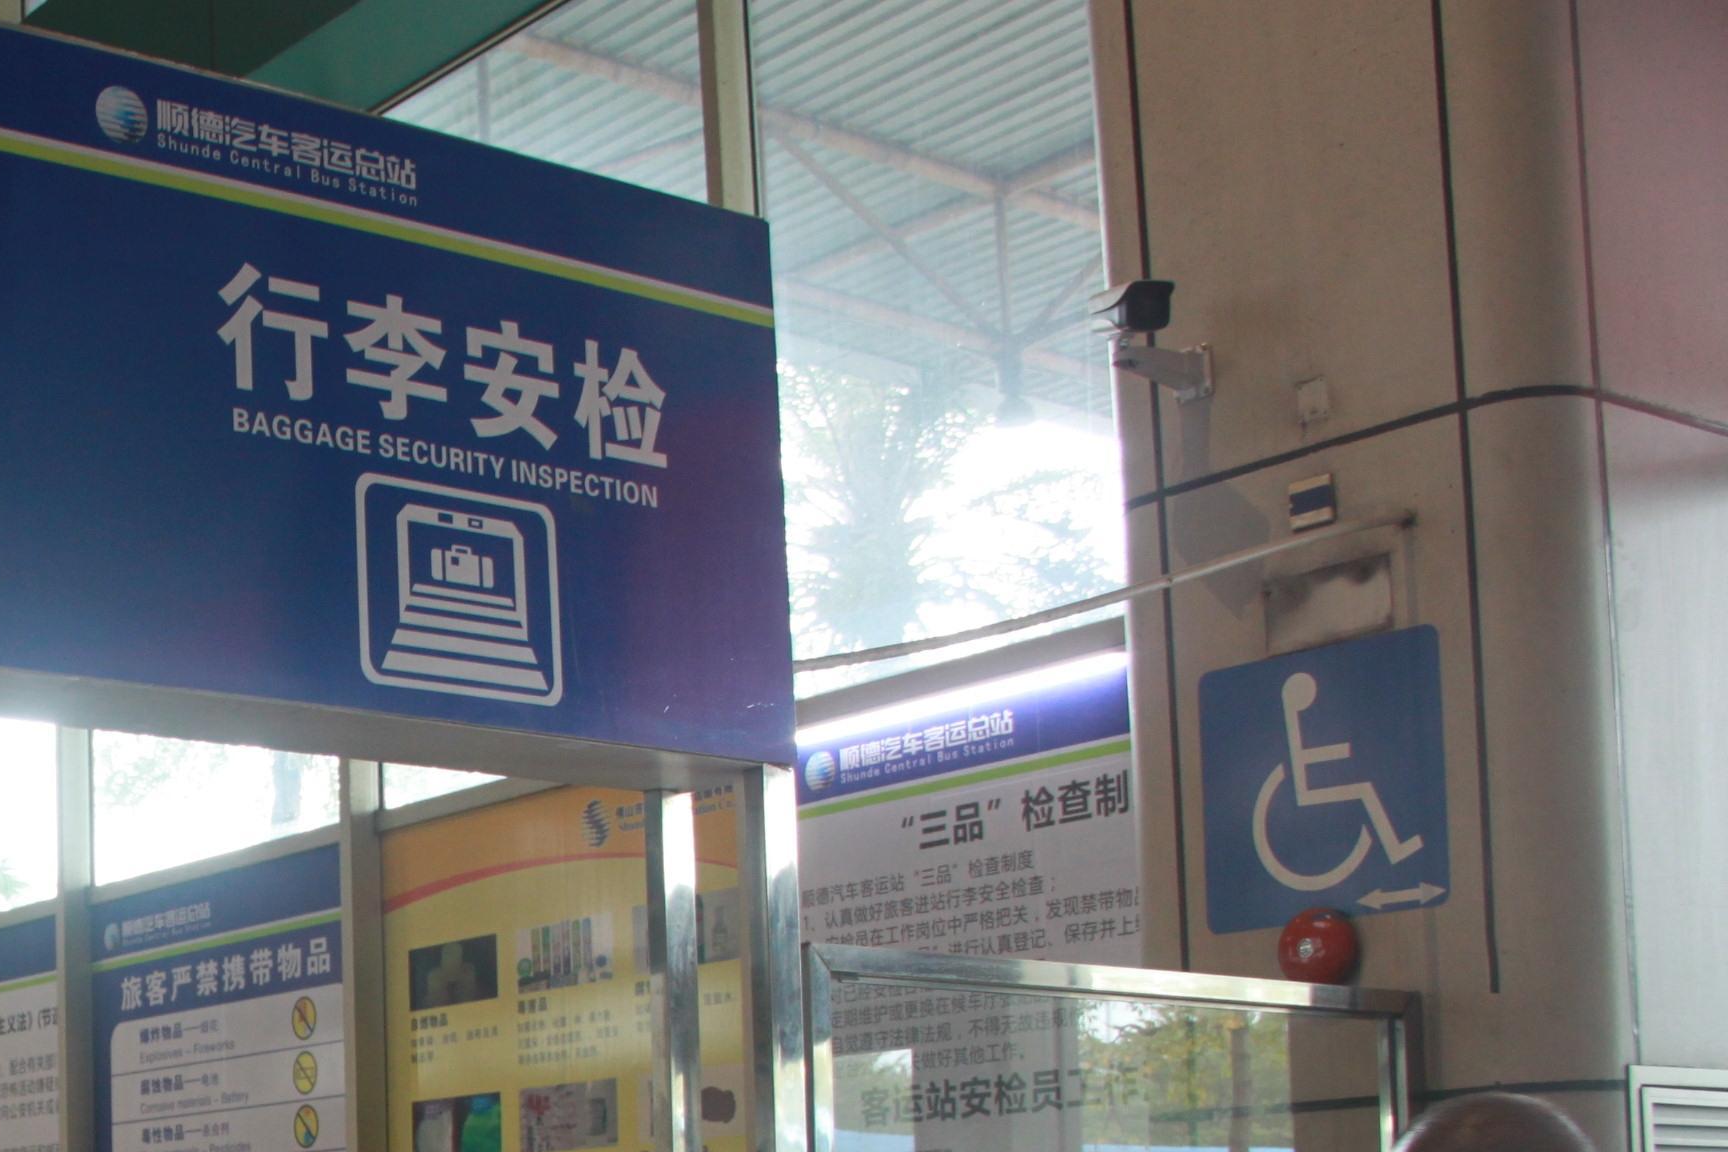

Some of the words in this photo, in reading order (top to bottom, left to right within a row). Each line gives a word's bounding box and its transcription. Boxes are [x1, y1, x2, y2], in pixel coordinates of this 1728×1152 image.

[156, 99, 417, 190] 顺德汽车客运总站
[157, 133, 221, 161] Shunde
[230, 150, 301, 180] Central
[311, 167, 340, 189] Bus
[348, 174, 418, 207] Station
[217, 262, 669, 469] 行李安检
[232, 408, 371, 455] BAGGAGE
[379, 434, 504, 480] SECURITY
[512, 459, 658, 508] INSPECTION
[839, 709, 1013, 771] 顺德汽车客运总站
[840, 767, 880, 784] Shunde
[884, 756, 932, 775] Central
[937, 748, 958, 763] Bus
[962, 737, 1015, 757] Station
[120, 937, 331, 1011] 旅客严禁携带物品
